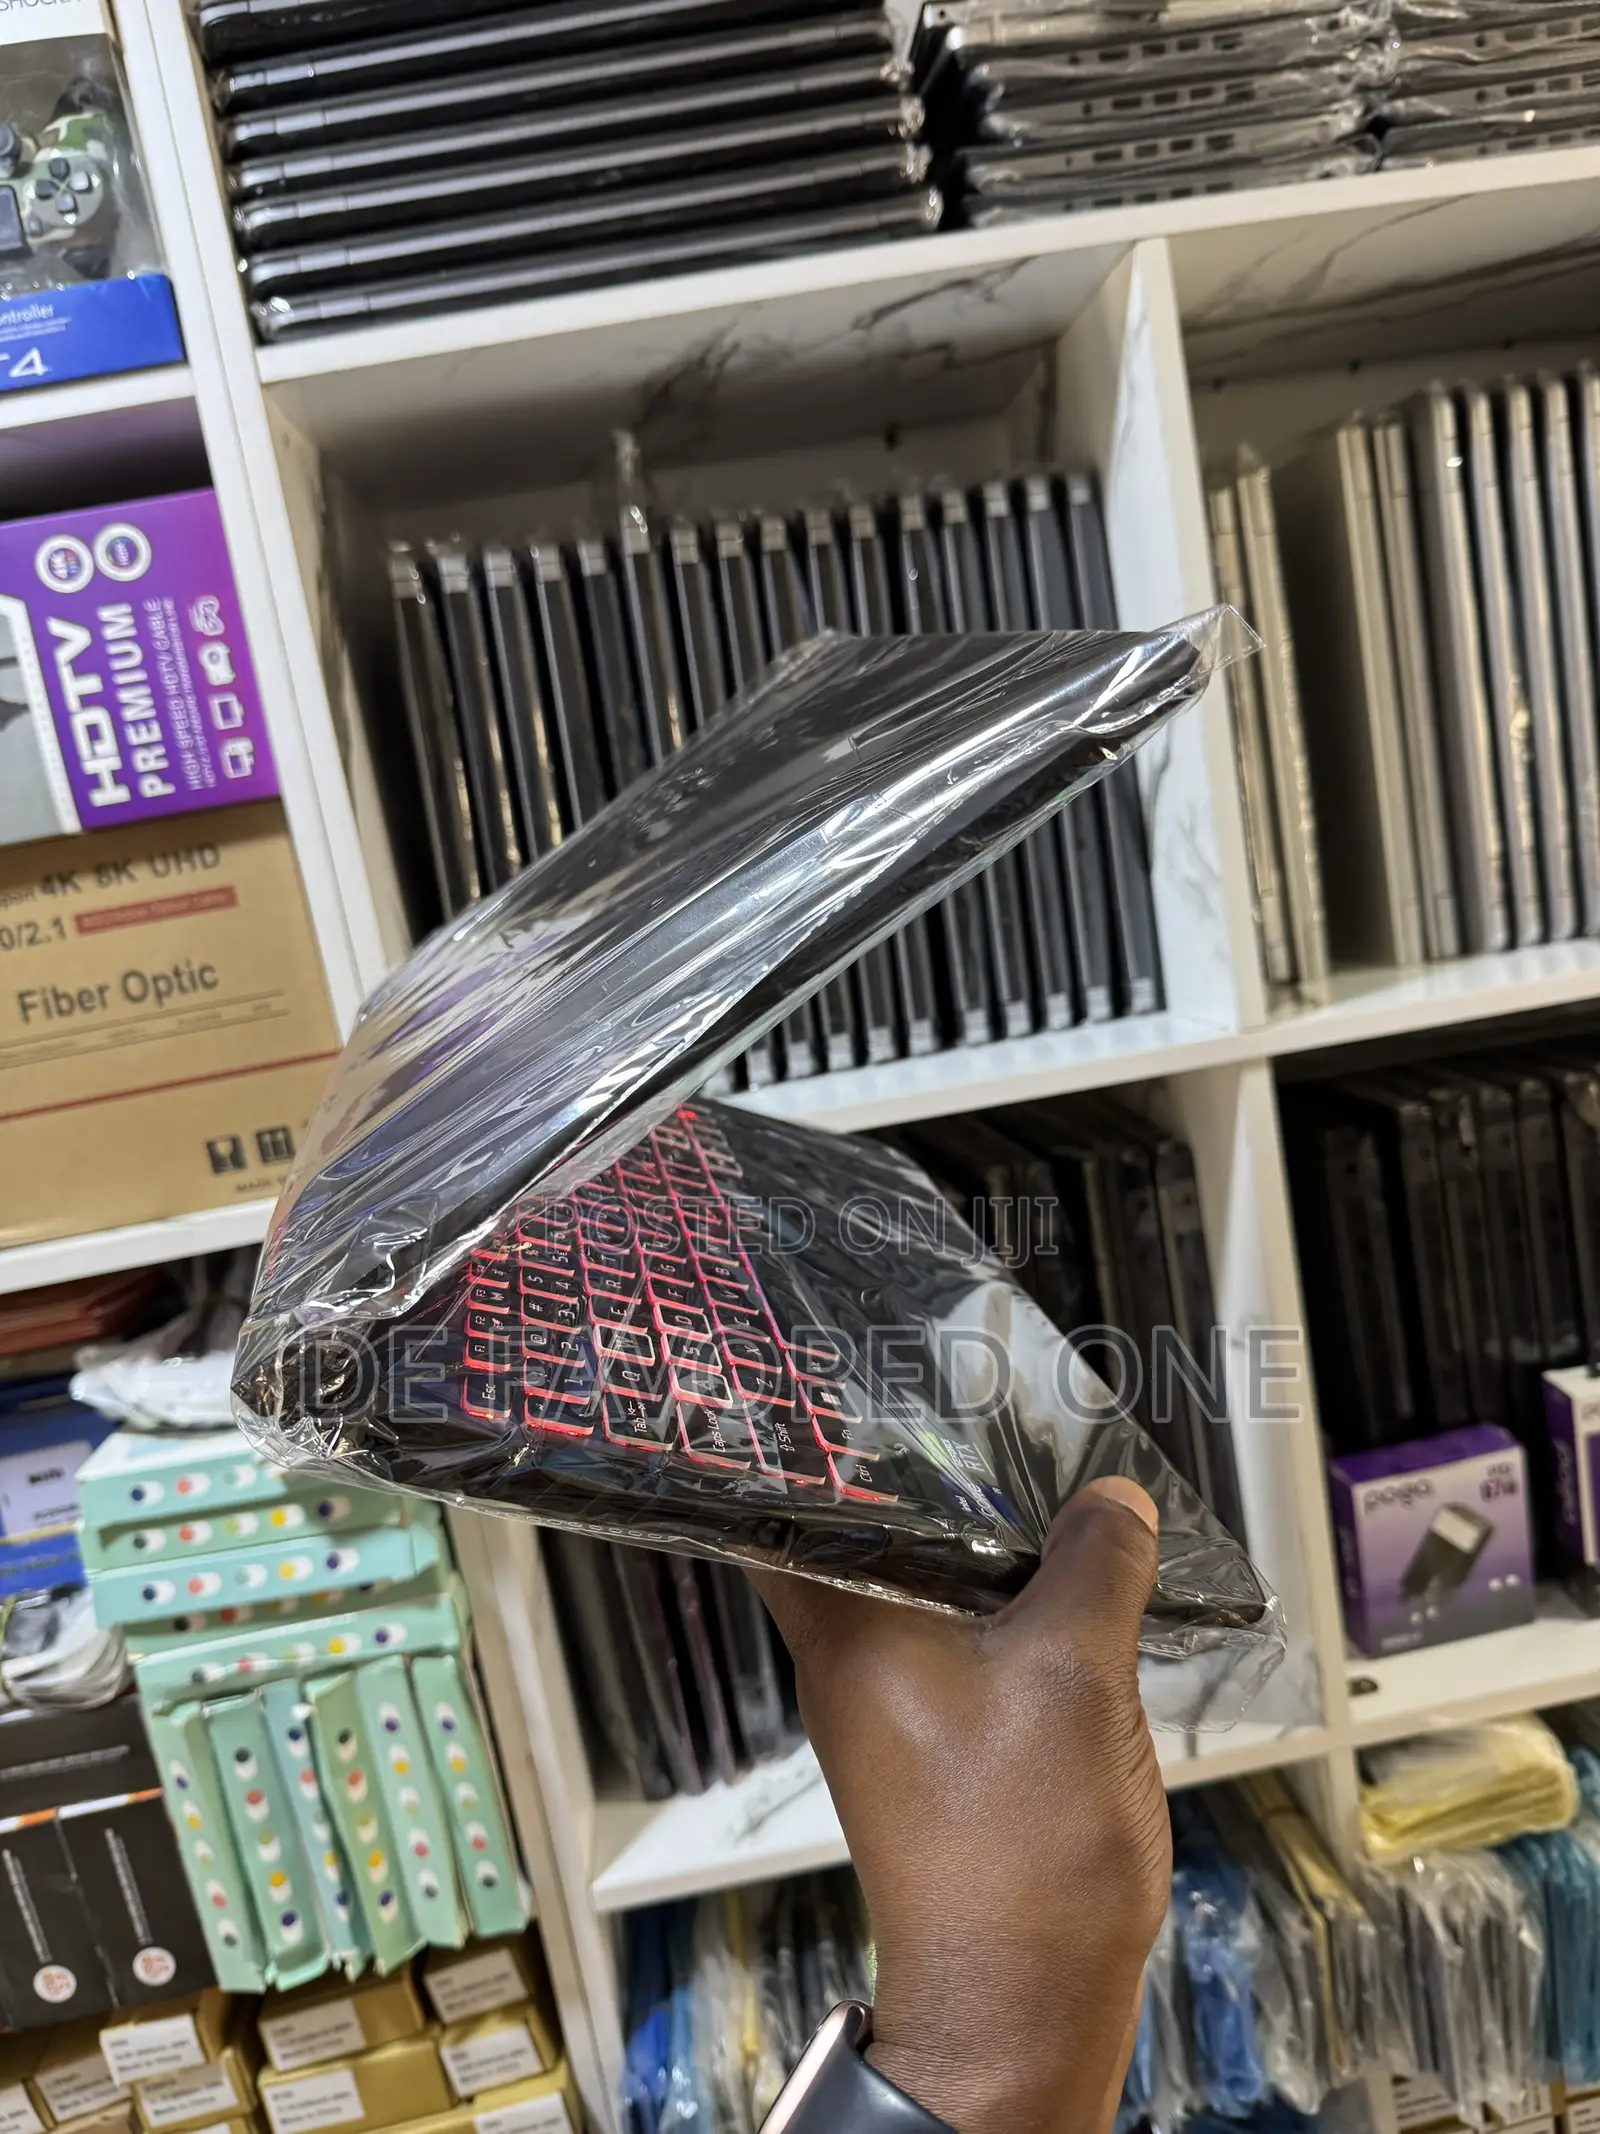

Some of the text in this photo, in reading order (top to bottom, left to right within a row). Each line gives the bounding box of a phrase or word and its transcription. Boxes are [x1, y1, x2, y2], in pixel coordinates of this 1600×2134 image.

[143, 596, 170, 652] CABLE
[157, 653, 180, 696] HDTV
[97, 602, 176, 799] PREMIUM
[46, 616, 132, 807] HDTV
[168, 698, 194, 750] SPEED
[181, 752, 202, 791] HIGH
[40, 870, 82, 899] 4K
[150, 844, 221, 879] UHD
[16, 984, 110, 1025] Fiber
[121, 959, 219, 1007] Optic
[552, 1255, 569, 1263] 5
[601, 1254, 616, 1262] T
[660, 1263, 676, 1272] G
[714, 1266, 730, 1276] B
[555, 1281, 571, 1290] 4
[606, 1279, 622, 1289] R
[476, 1288, 486, 1297] F3
[667, 1288, 683, 1298] F
[528, 1302, 544, 1312] #
[558, 1303, 575, 1320] 3
[610, 1305, 627, 1316] E
[476, 1315, 485, 1325] F2
[674, 1315, 692, 1326] D
[530, 1333, 547, 1345] @
[561, 1341, 579, 1351] 2
[682, 1345, 700, 1356] S
[744, 1345, 761, 1355] X
[622, 1370, 641, 1381] Q
[692, 1380, 711, 1391] A
[756, 1377, 773, 1388] Z
[482, 1383, 495, 1400] Esc
[634, 1417, 647, 1433] Tab
[704, 1408, 726, 1453] Caps Lock
[774, 1422, 792, 1443] Shift
[842, 1429, 854, 1440] Fn
[951, 1440, 986, 1472] RTX
[855, 1464, 872, 1482] Ctrl
